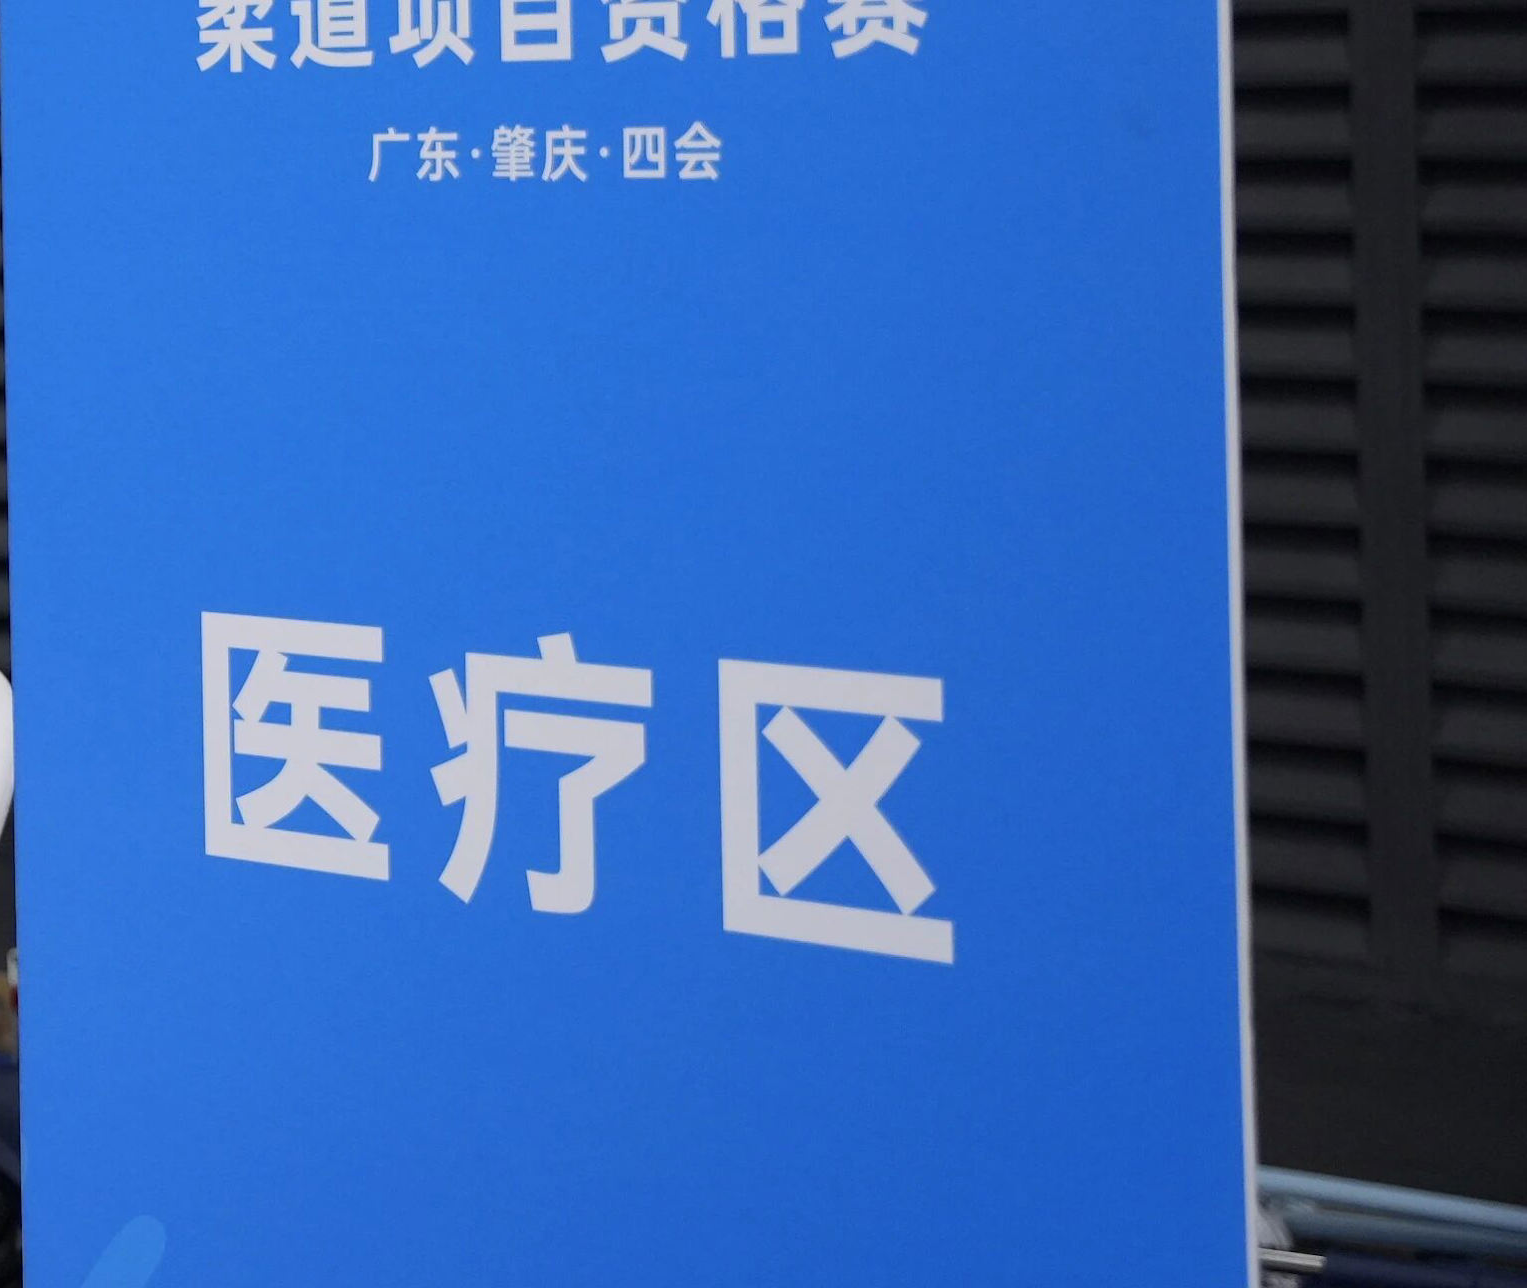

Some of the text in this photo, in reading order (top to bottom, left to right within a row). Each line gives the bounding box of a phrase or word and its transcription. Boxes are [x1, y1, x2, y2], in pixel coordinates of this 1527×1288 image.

[368, 121, 722, 182] 广东·肇庆·四会
[201, 611, 954, 964] 医疗区
